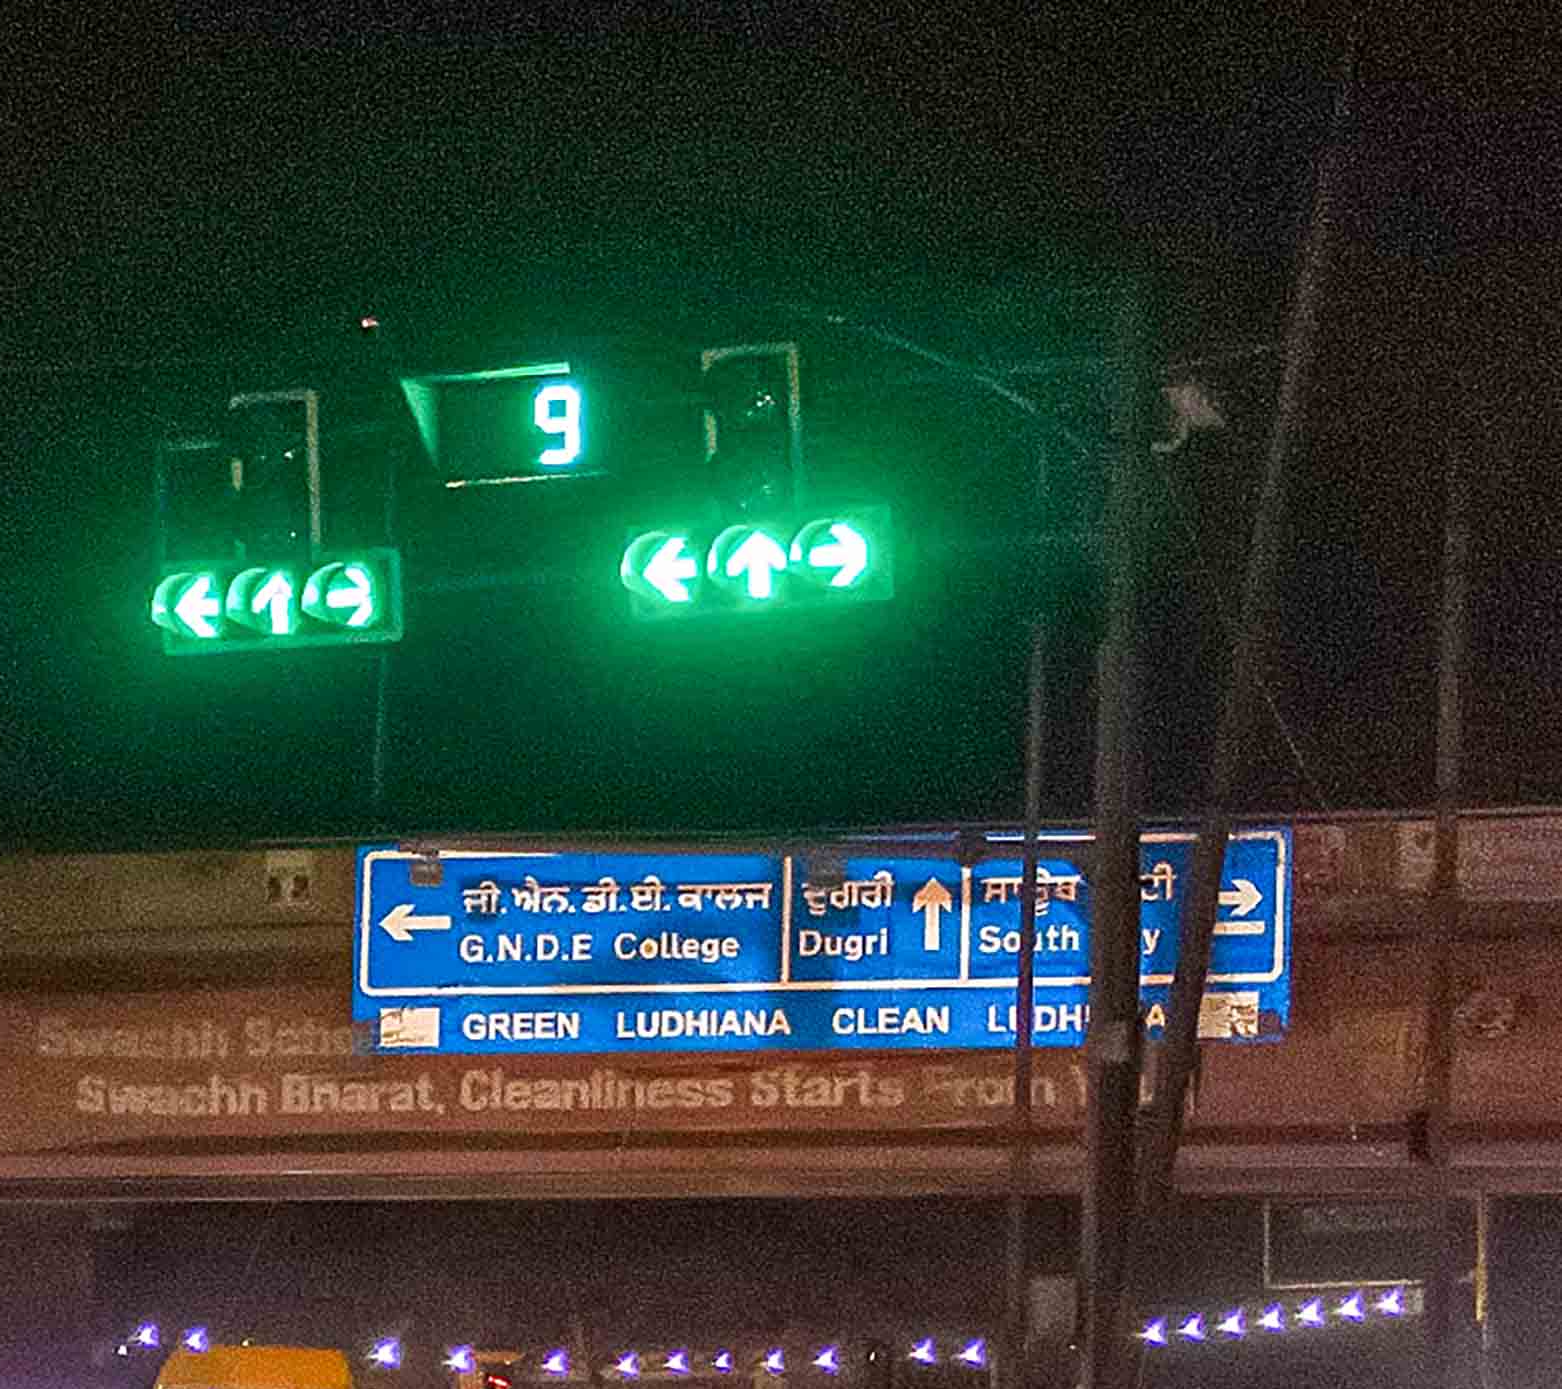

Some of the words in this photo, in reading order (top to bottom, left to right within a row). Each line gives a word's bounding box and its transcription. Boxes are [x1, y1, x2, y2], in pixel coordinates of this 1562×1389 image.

[533, 384, 582, 466] 9
[676, 882, 773, 911] ਕਾਲਜ
[801, 869, 896, 916] ਦੁਗਰੀ
[459, 932, 593, 964] G.N.D.E
[613, 931, 741, 962] College
[798, 929, 889, 961] Dugri
[462, 1011, 580, 1041] GREEN
[616, 1008, 792, 1039] LUDHIANA
[831, 1006, 950, 1035] CLEAN
[457, 1068, 734, 1113] Cleanliness
[750, 1067, 903, 1107] Starts
